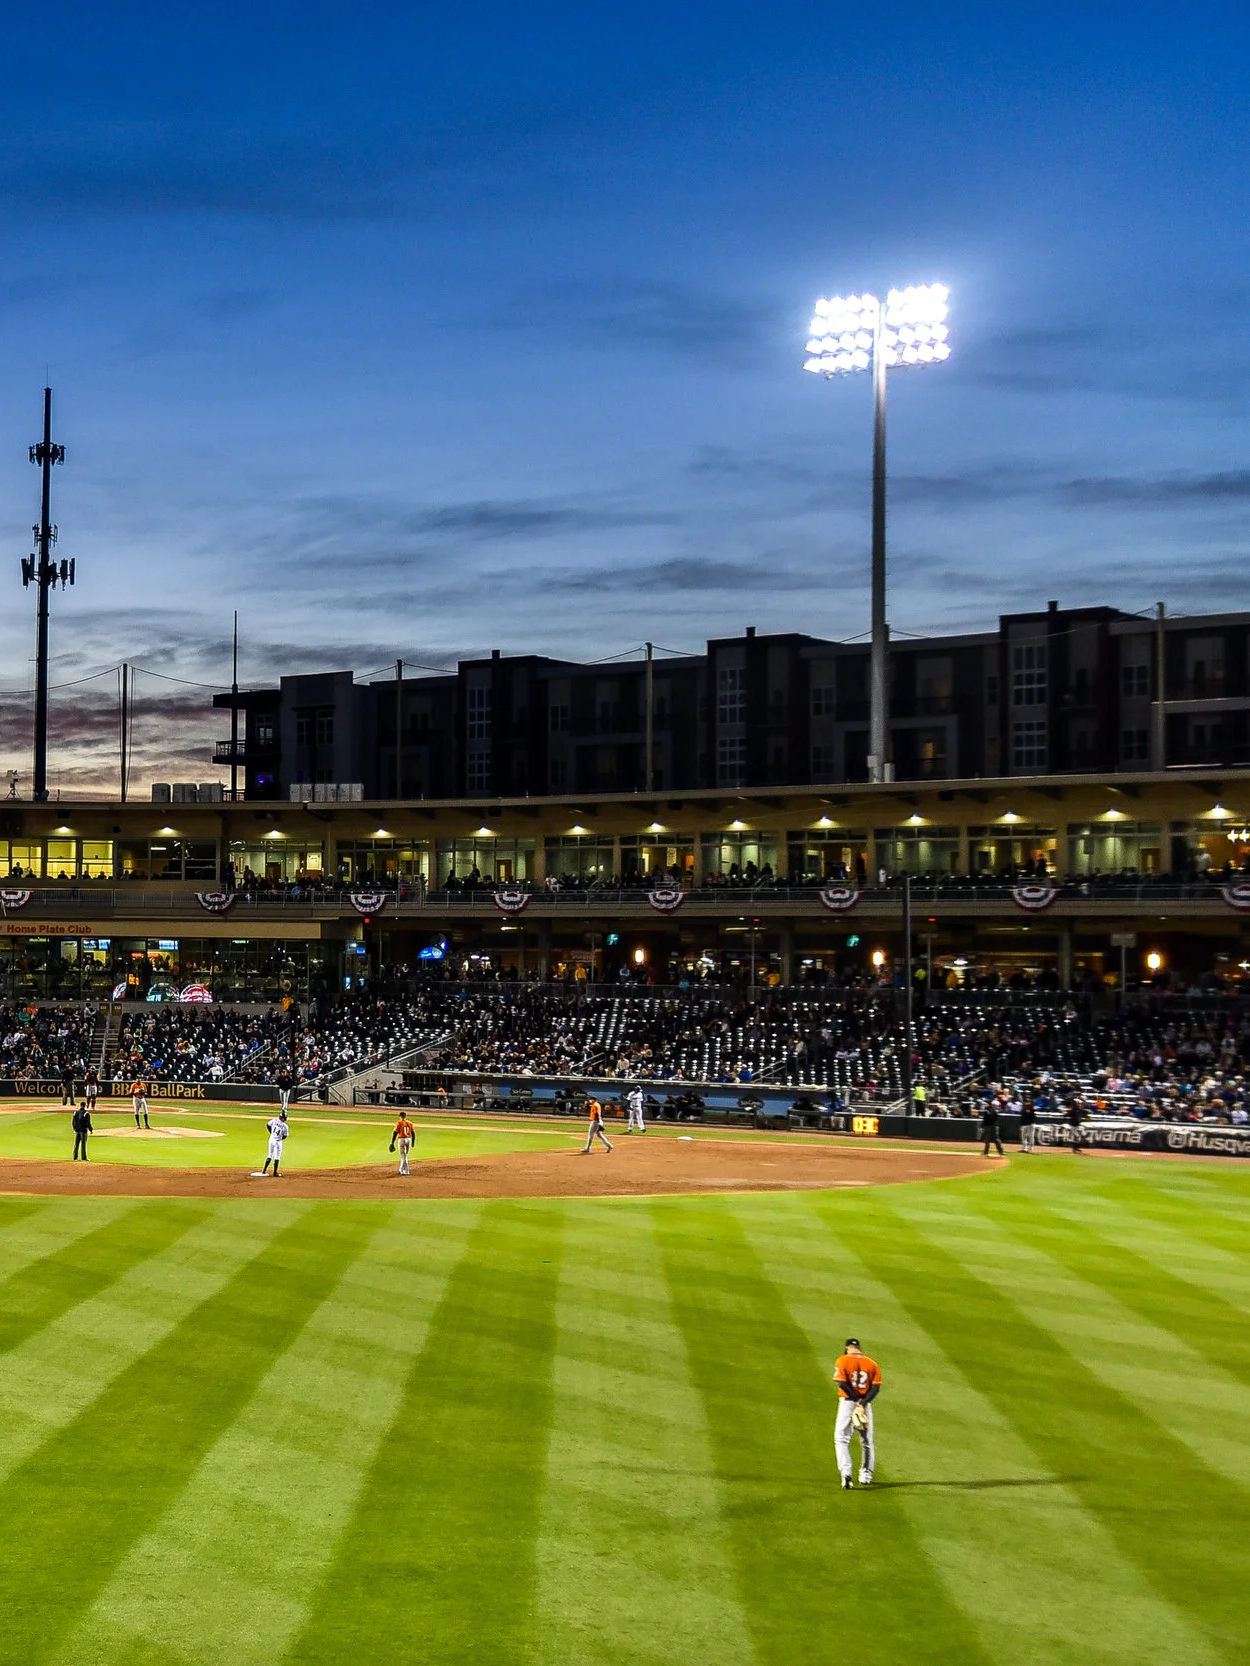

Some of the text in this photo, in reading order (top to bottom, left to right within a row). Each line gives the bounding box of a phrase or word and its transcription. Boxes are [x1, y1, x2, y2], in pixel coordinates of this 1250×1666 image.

[6, 924, 37, 934] Home
[39, 924, 65, 934] Plate
[67, 924, 92, 934] Club
[151, 1083, 205, 1098] BallPark
[851, 1370, 868, 1389] 12
